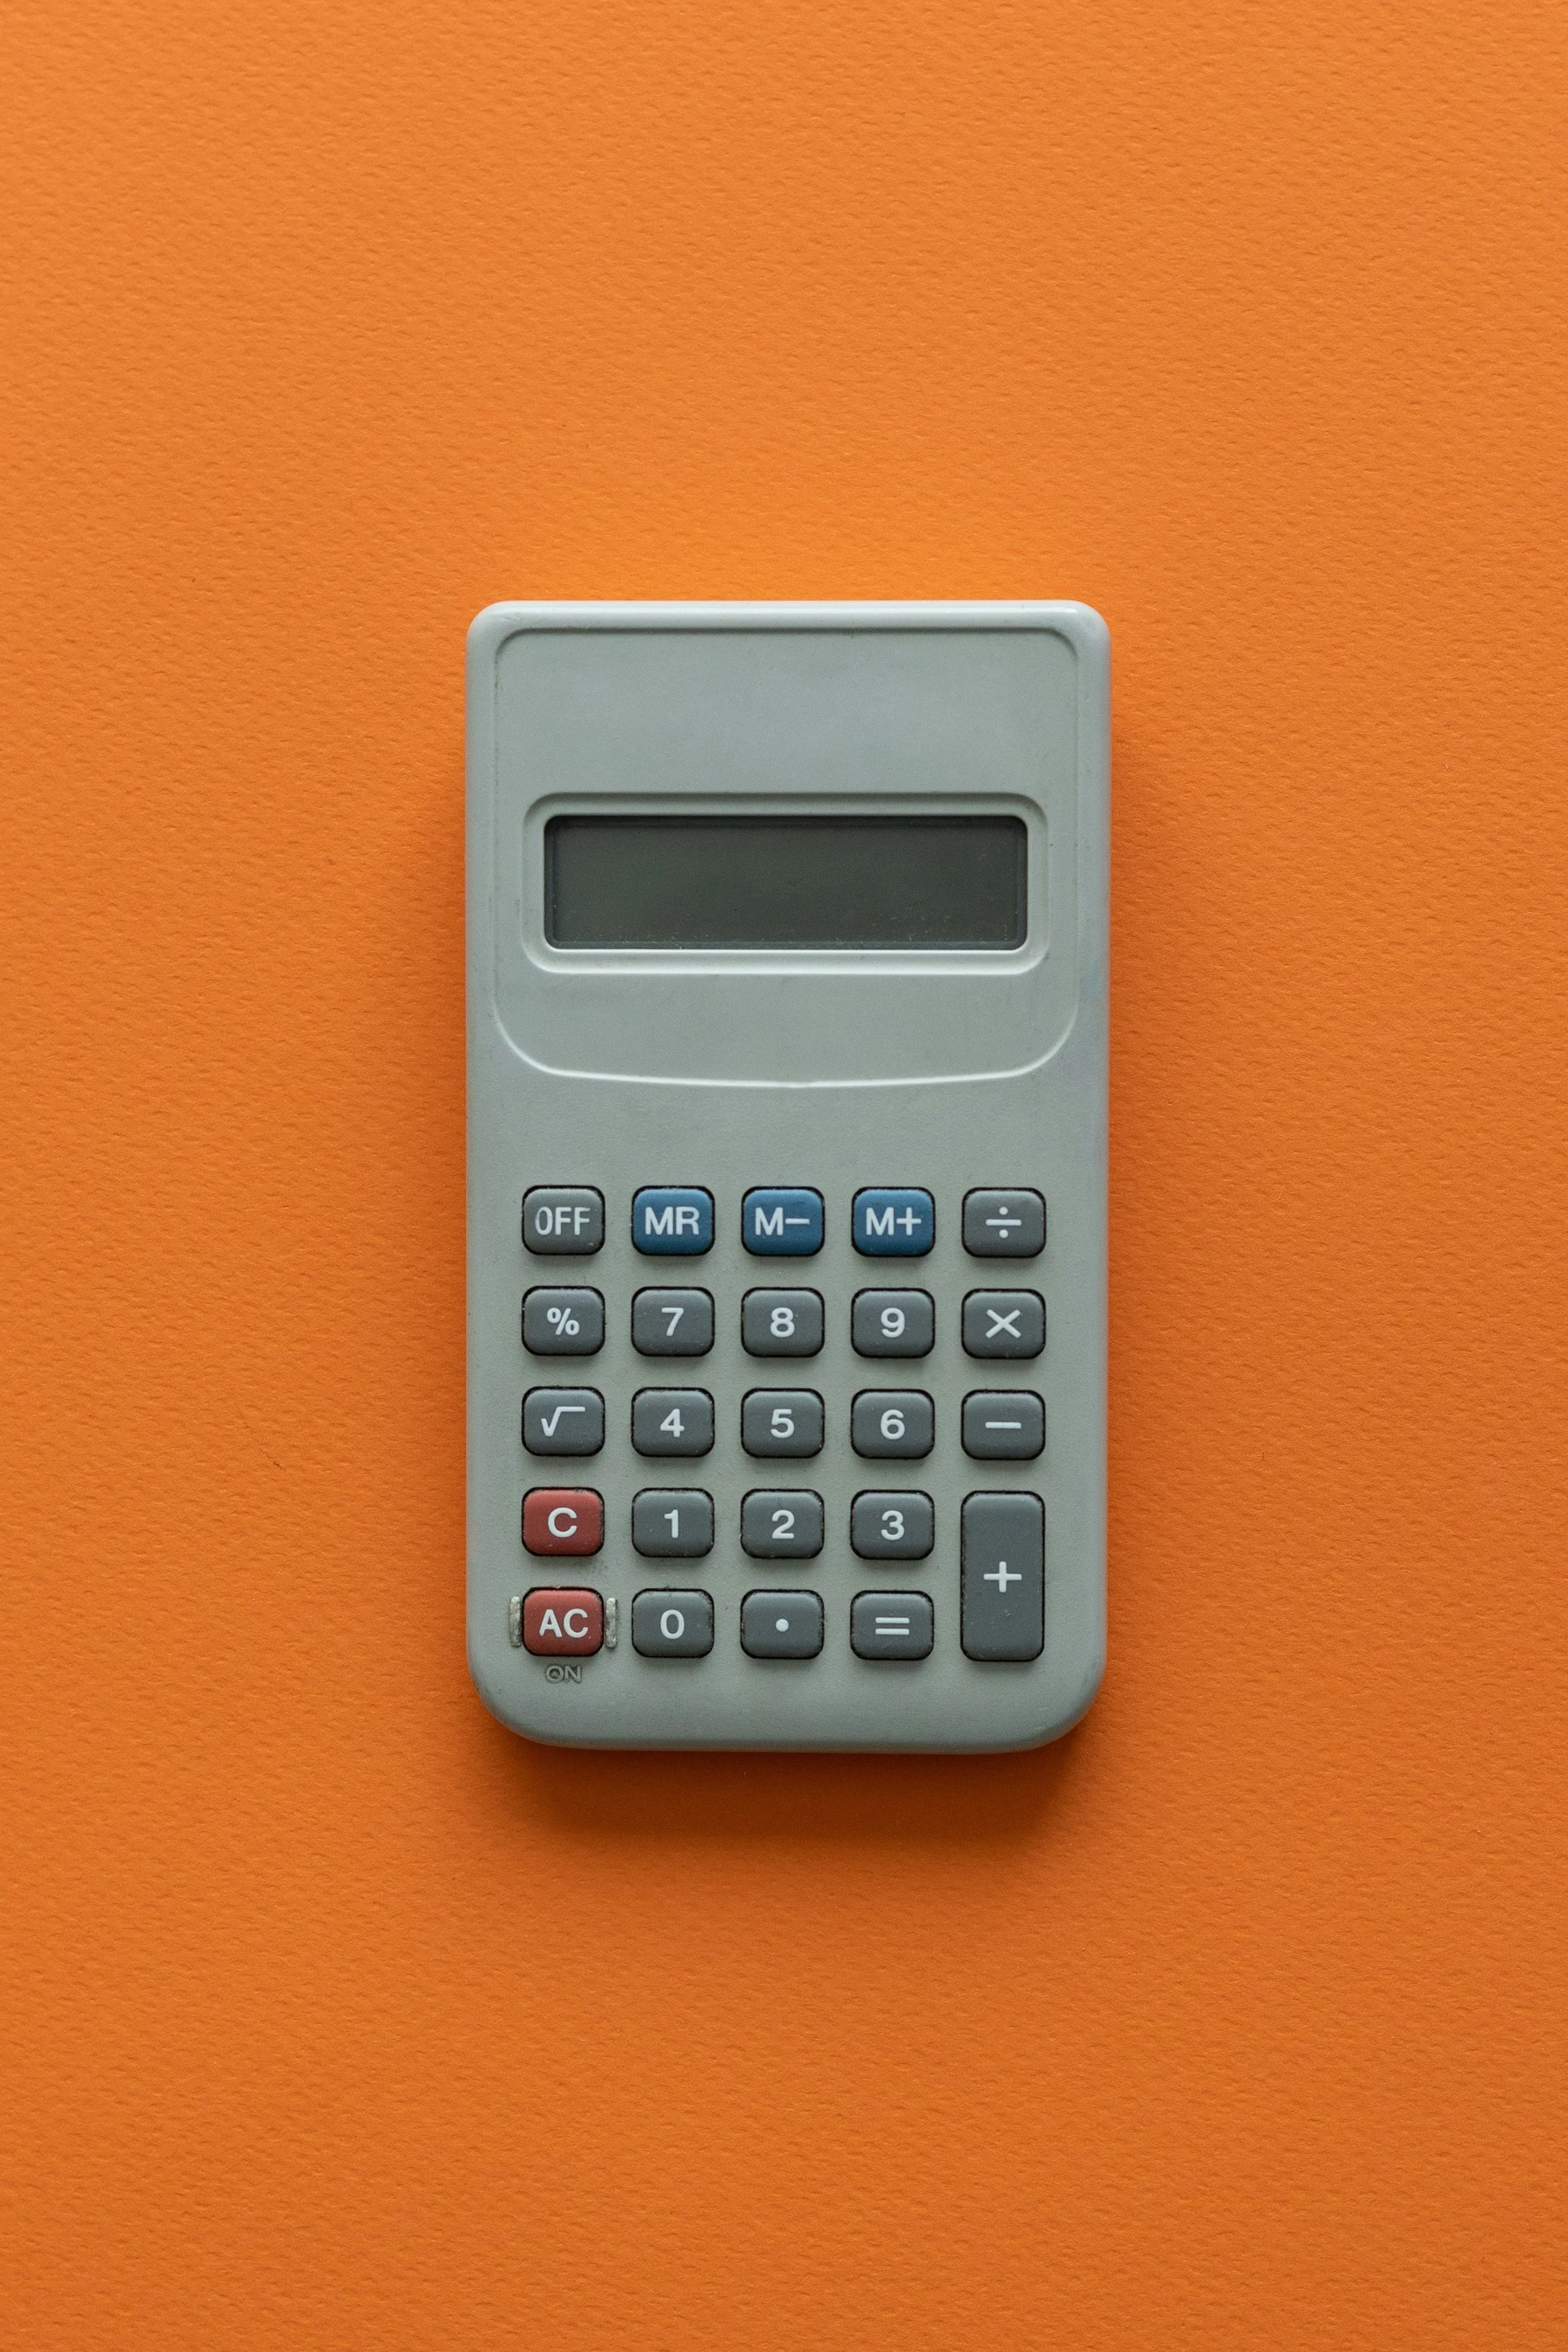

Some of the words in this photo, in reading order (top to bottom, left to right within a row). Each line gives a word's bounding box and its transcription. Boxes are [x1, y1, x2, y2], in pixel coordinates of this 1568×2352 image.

[536, 1207, 590, 1235] OFF
[646, 1207, 699, 1234] MR
[867, 1207, 921, 1235] M+
[548, 1308, 579, 1335] %
[662, 1308, 684, 1335] 7
[771, 1308, 794, 1337] 8
[881, 1308, 904, 1337] 9
[660, 1409, 684, 1437] 4
[771, 1409, 794, 1437] 5
[881, 1410, 904, 1439] 6
[548, 1508, 576, 1537] C
[665, 1510, 678, 1537] 1
[773, 1510, 794, 1538] 2
[881, 1510, 904, 1540] 3
[540, 1609, 588, 1638] AC
[661, 1609, 684, 1639] 0
[545, 1665, 582, 1683] ON
